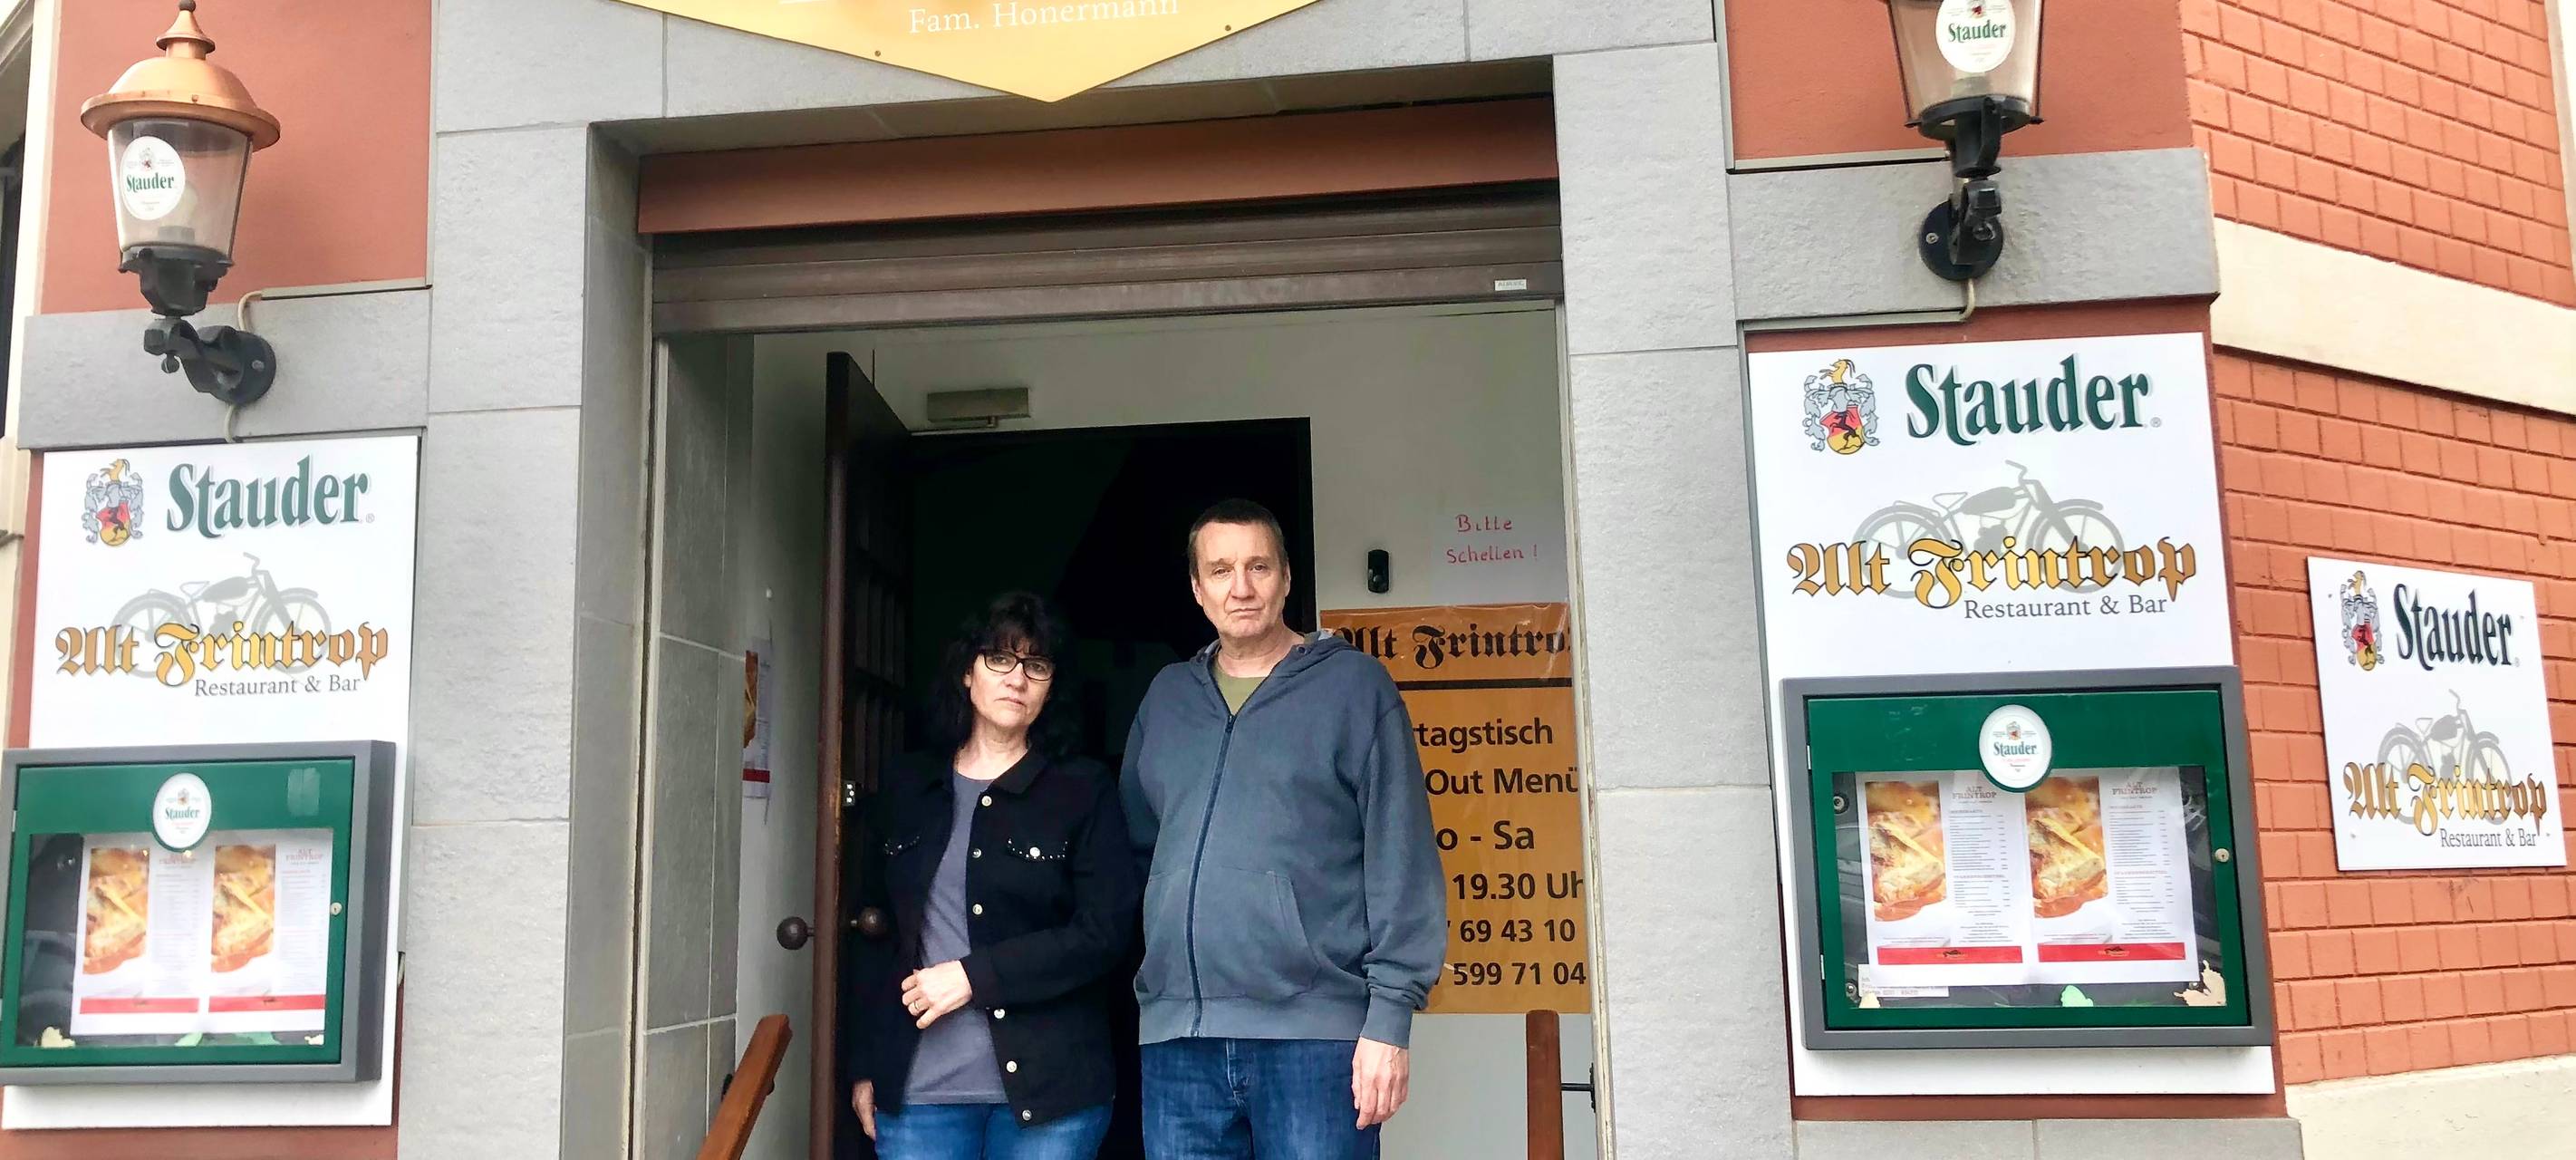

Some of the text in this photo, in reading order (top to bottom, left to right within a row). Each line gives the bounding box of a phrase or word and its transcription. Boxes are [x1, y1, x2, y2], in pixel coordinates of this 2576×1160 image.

[909, 0, 1180, 34] Fam. Honermann
[1948, 19, 2006, 43] Stauder
[126, 171, 175, 193] Stauder
[1905, 353, 2148, 446] Stauder
[166, 455, 369, 538] Stauder
[1455, 514, 1512, 532] Bitte
[1446, 545, 1524, 564] Schellen
[1786, 535, 2197, 609] Alt Frintrop
[1964, 594, 2167, 620] Restaurant & Bar
[2393, 583, 2513, 671] Stauder
[54, 620, 390, 688] Alt Frintrop
[1412, 623, 1571, 669] Frintro
[194, 675, 361, 697] Restaurant & Bar
[1413, 717, 1553, 754] tagstisch
[1993, 741, 2038, 757] Stauder
[1424, 767, 1578, 796] Out Menü
[165, 806, 200, 820] Stauder
[2343, 761, 2548, 836] Alt Frintrop
[1435, 828, 1458, 850] o
[1493, 820, 1535, 850] Sa
[2440, 827, 2537, 848] Restaurant & Bar
[1452, 871, 1584, 900] 19.30 Uh
[1460, 918, 1576, 942] 69 43 10
[1453, 962, 1587, 986] 599 71 04
